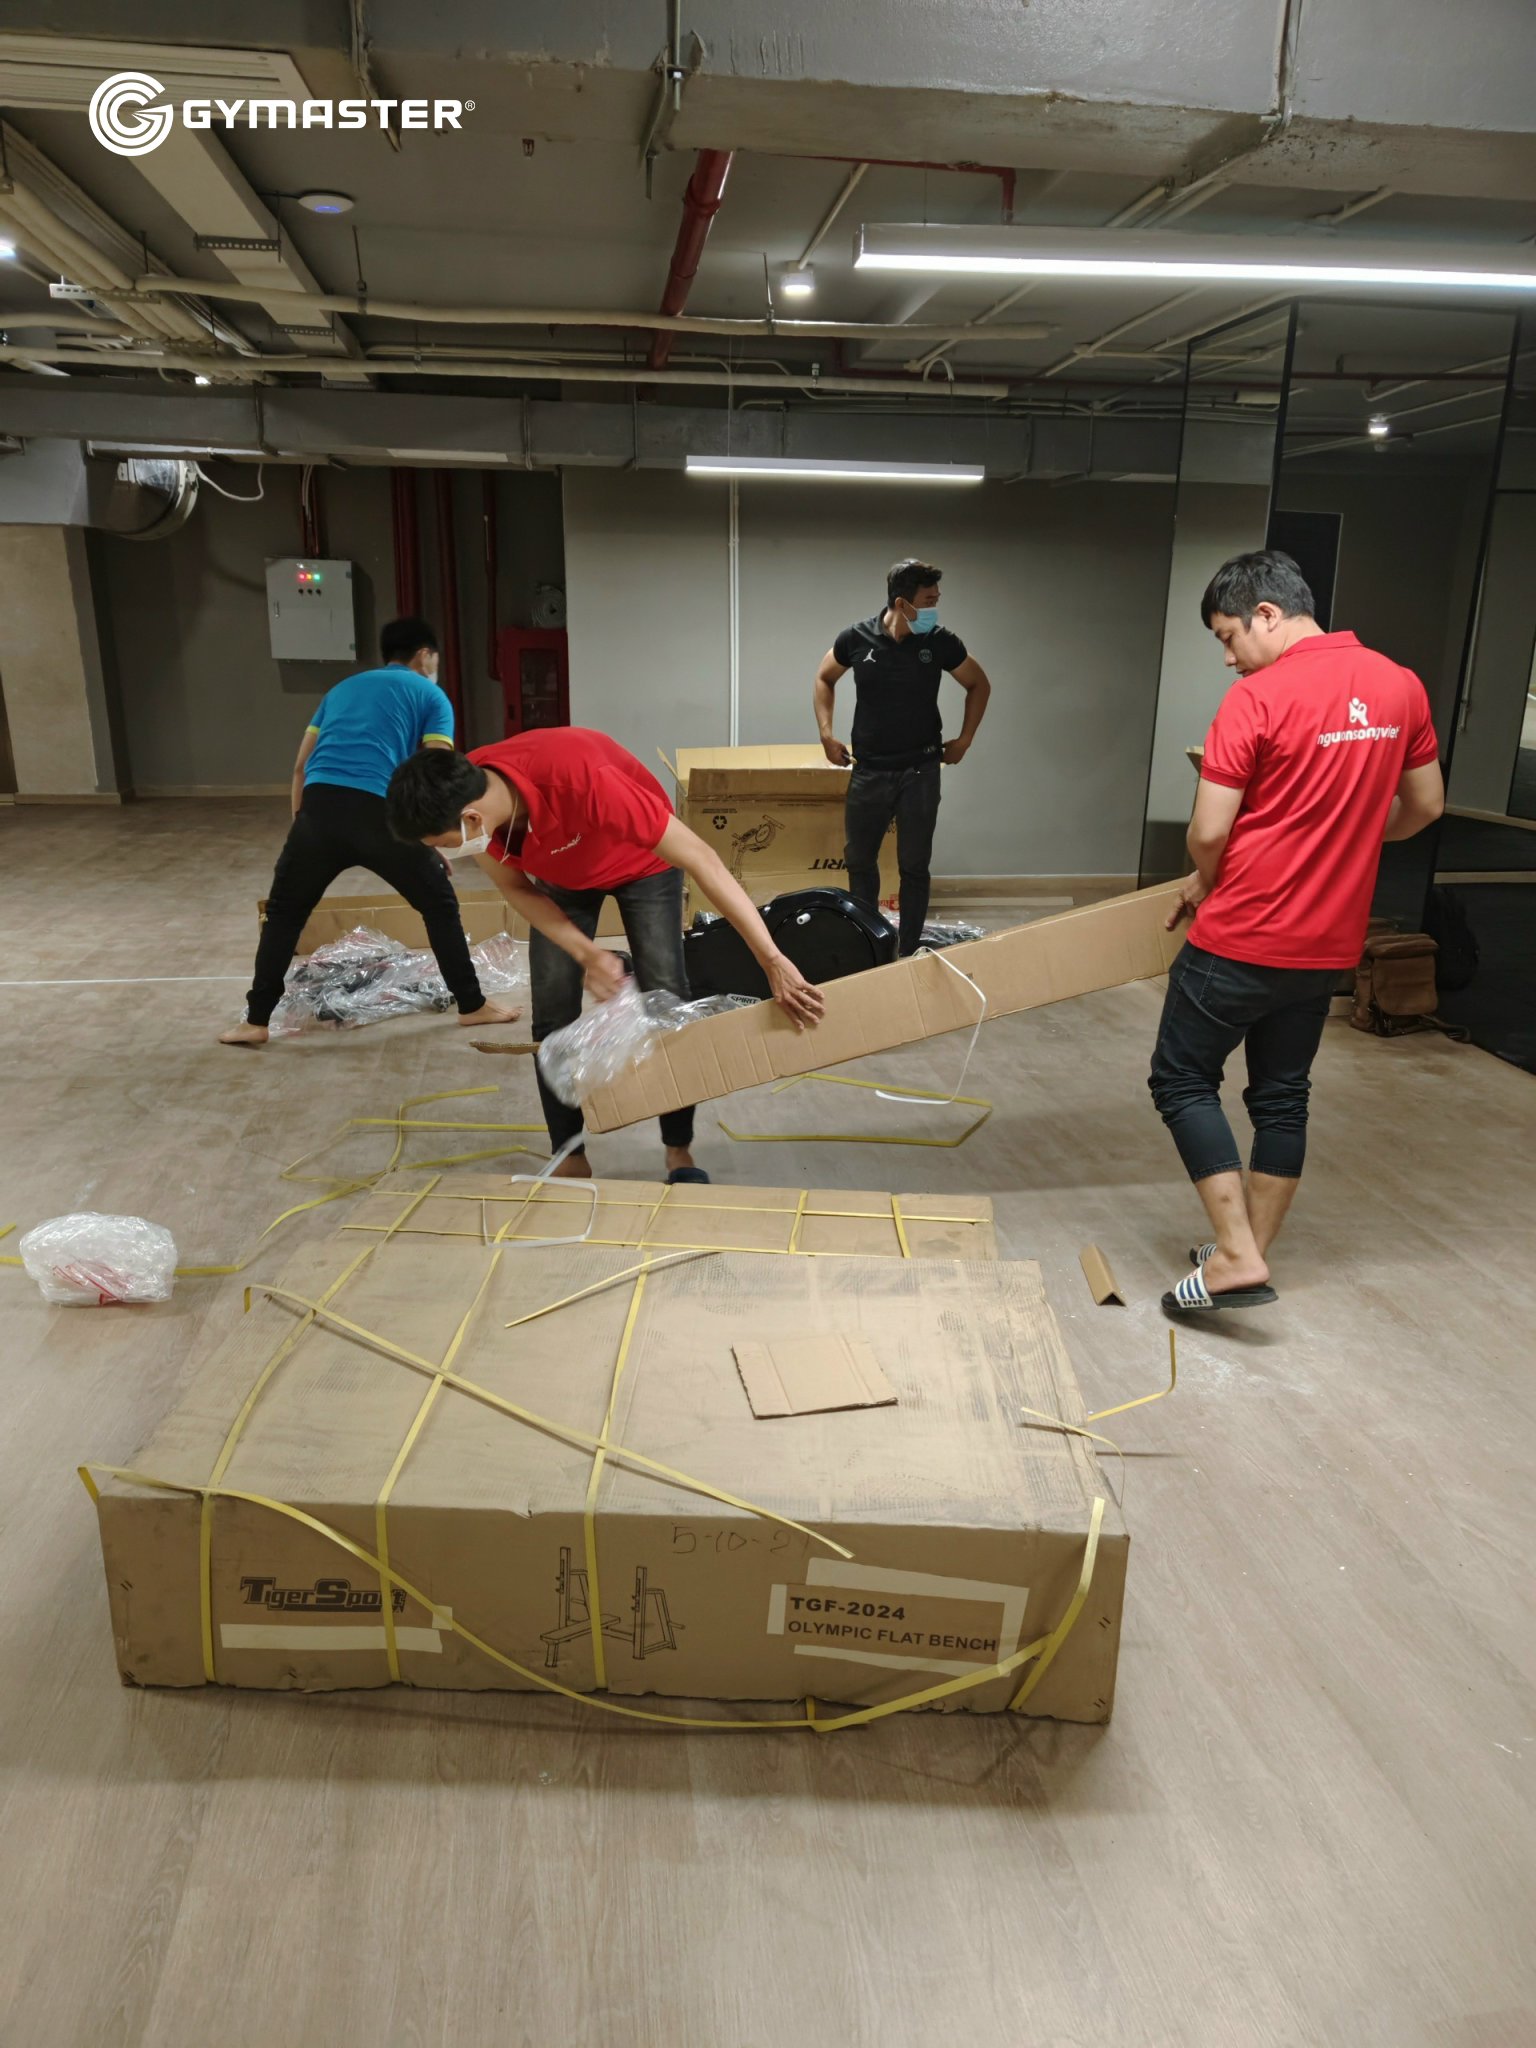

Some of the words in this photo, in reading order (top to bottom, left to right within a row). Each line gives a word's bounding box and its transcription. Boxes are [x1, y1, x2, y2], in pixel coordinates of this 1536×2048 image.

[790, 1596, 905, 1621] TGF-2024
[788, 1620, 873, 1640] OLYMPIC
[877, 1629, 925, 1645] FLAT
[929, 1634, 997, 1652] BENCH
